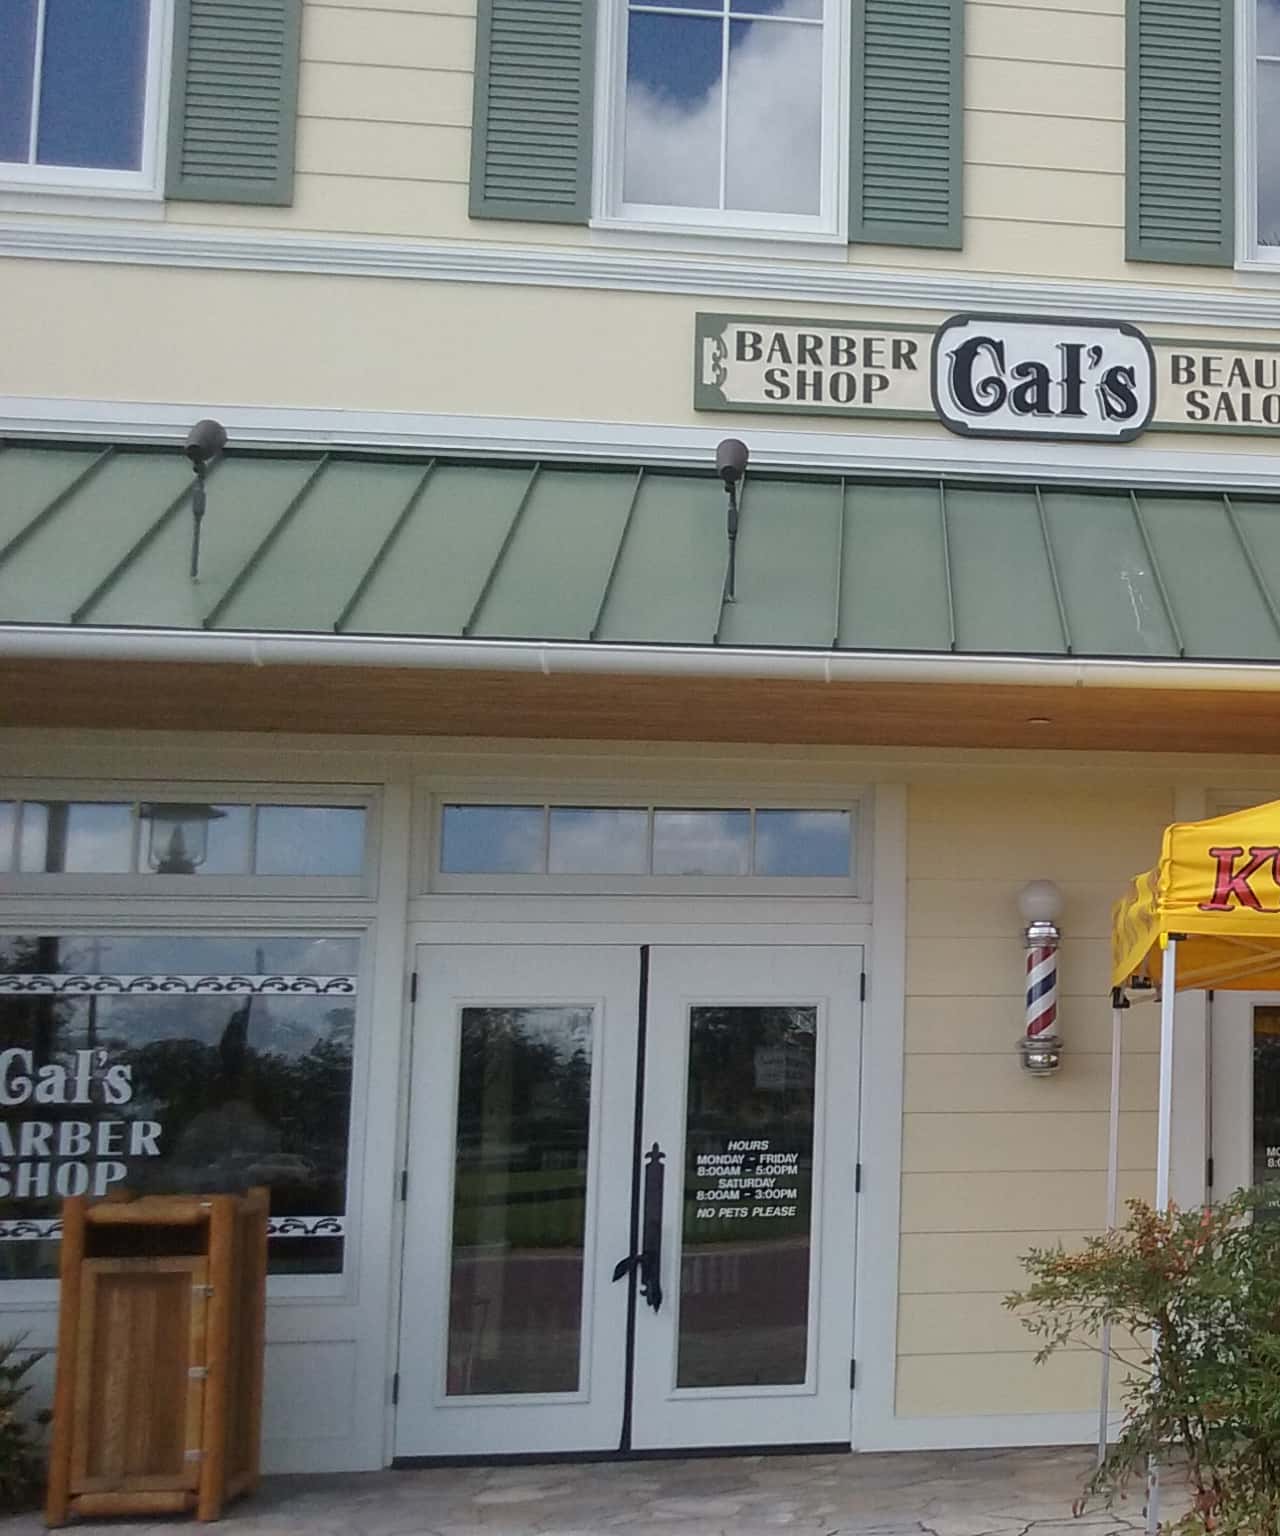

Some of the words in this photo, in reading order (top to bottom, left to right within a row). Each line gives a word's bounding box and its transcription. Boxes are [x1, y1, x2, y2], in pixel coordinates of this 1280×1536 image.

[735, 330, 919, 370] BARBER
[945, 336, 1138, 422] Cal's
[763, 367, 889, 404] SHOP
[727, 1140, 769, 1151] HOURS
[696, 1154, 745, 1165] MONDAY
[759, 1153, 799, 1164] FRIDAY
[697, 1165, 741, 1176] 8:00AM
[755, 1165, 798, 1175] 5:00PM
[718, 1178, 776, 1189] SATURDAY
[696, 1190, 740, 1201] 8:00AM
[755, 1189, 797, 1200] 3:00PM
[696, 1208, 715, 1219] NO
[718, 1207, 748, 1218] PETS
[752, 1206, 797, 1217] PLEASE
